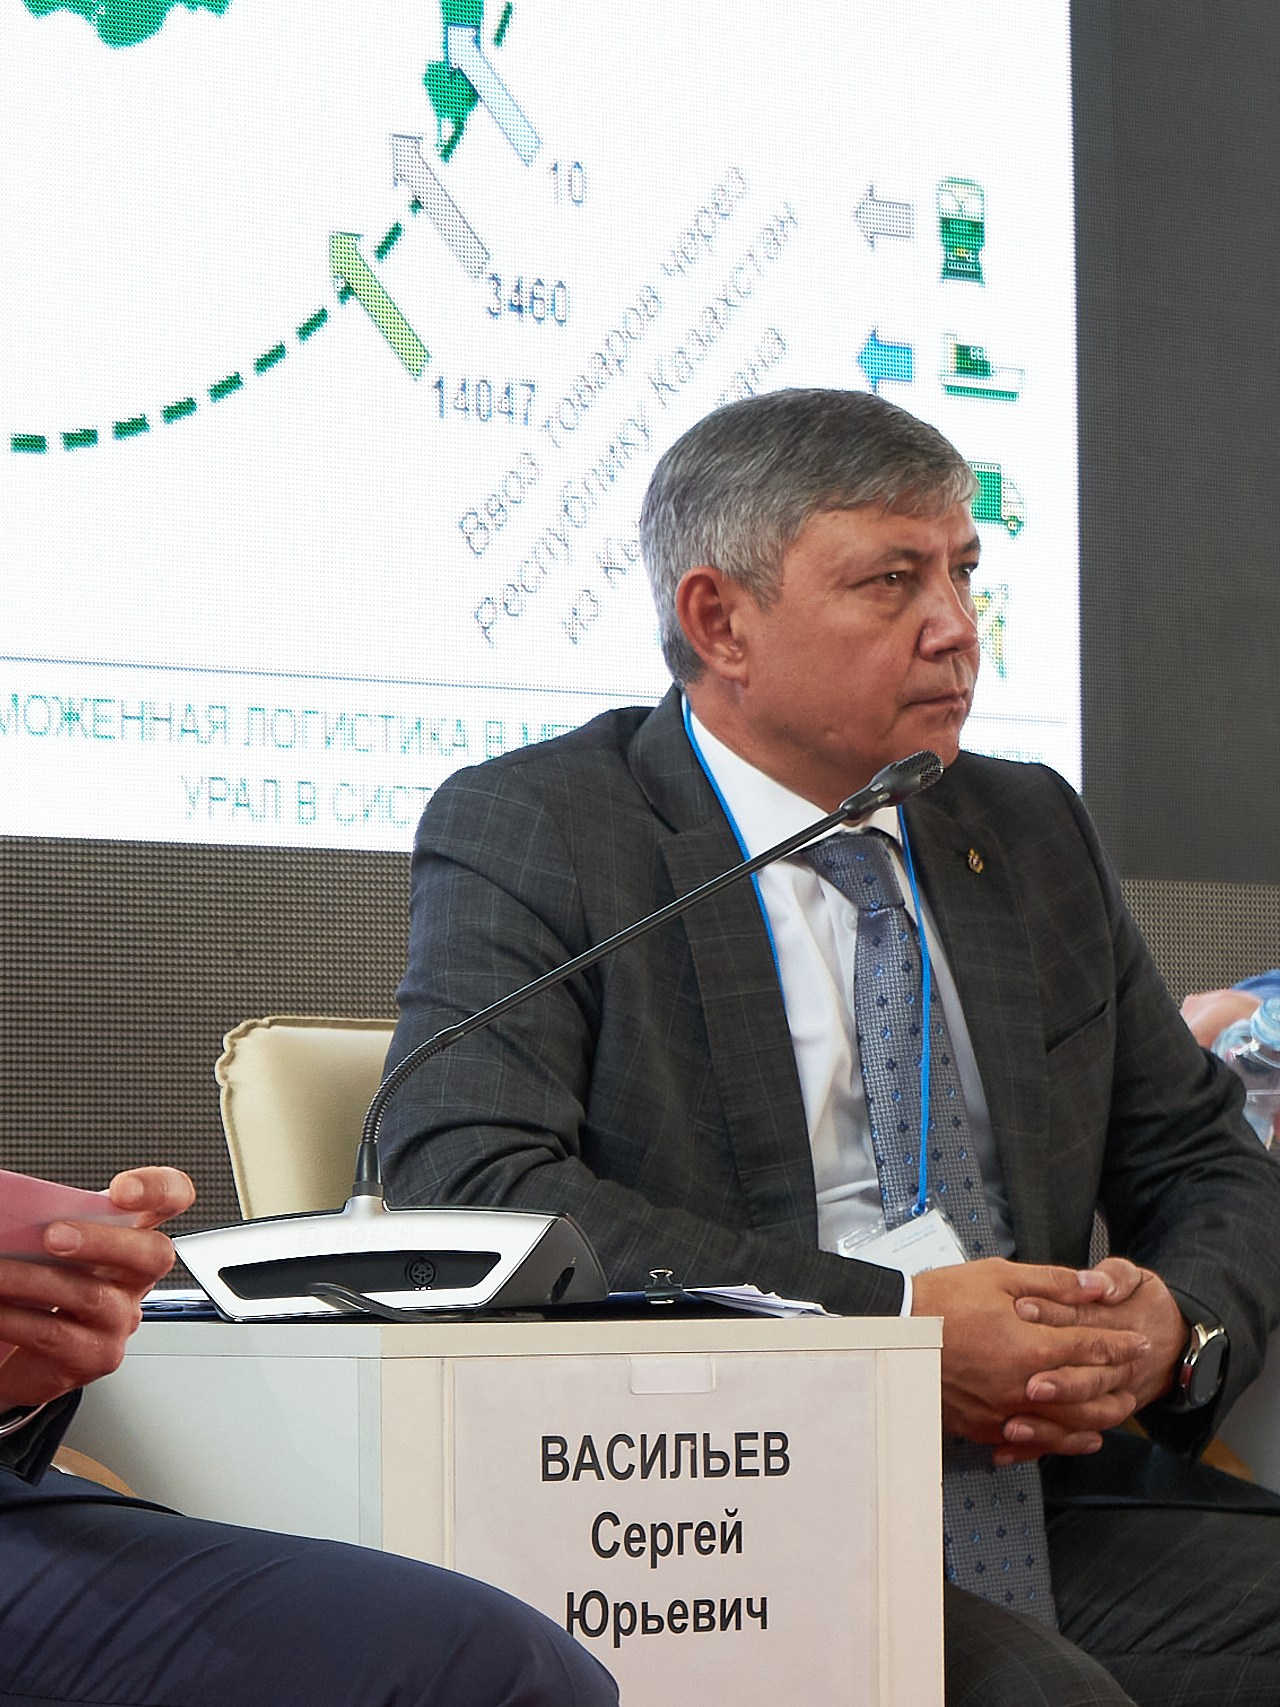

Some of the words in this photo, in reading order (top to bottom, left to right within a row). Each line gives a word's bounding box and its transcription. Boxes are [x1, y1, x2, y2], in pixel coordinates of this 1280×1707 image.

[550, 160, 588, 205] 10
[486, 272, 568, 326] 3460
[459, 452, 541, 557] Ввоз
[544, 285, 662, 447] товаров
[661, 166, 748, 278] через
[433, 377, 535, 425] 14047
[474, 403, 652, 647] Республику
[649, 201, 798, 407] Казахстан
[244, 706, 469, 756] ЛОГИСТИКА
[485, 720, 505, 759] В
[181, 775, 280, 823] УРАЛ
[297, 780, 317, 826] В
[336, 783, 432, 828] СИСТ
[541, 1432, 790, 1482] ВАСИЛЬЕВ
[591, 1508, 744, 1569] Сергей
[566, 1590, 768, 1649] Юрьевич
